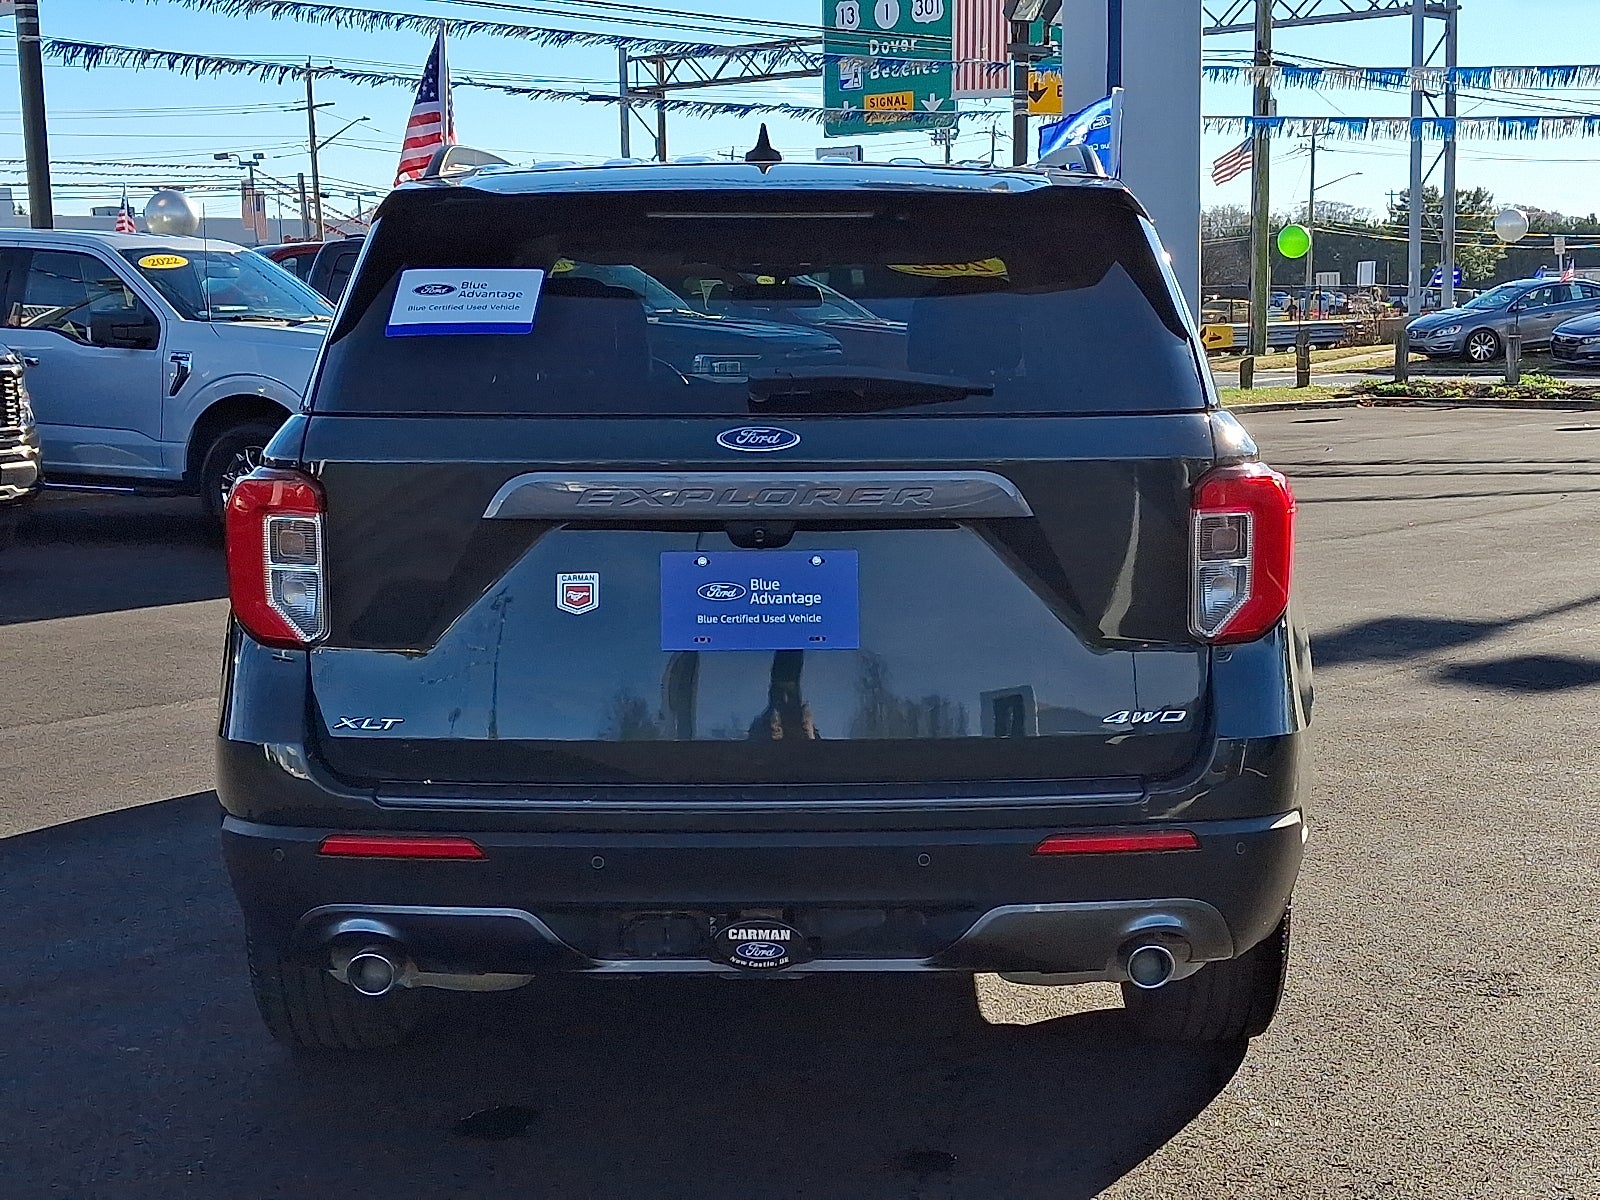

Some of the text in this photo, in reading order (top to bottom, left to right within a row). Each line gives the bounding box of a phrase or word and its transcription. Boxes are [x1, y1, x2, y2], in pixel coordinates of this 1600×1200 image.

[885, 3, 890, 21] 1
[914, 0, 940, 17] 301
[840, 6, 855, 25] 13
[869, 39, 918, 56] Dover
[869, 95, 908, 108] SIGNAL
[148, 257, 180, 267] 2022
[420, 284, 449, 295] Ford
[461, 281, 488, 290] Blue
[458, 290, 523, 300] Advantage
[407, 304, 426, 312] Blue
[735, 429, 782, 446] Ford
[575, 486, 936, 508] EXPLORER
[561, 574, 595, 582] CARMAN
[750, 578, 780, 591] Blue
[706, 584, 737, 598] Ford
[750, 592, 822, 606] Advantage
[697, 613, 822, 624] Blue Certified Used Vehicle
[333, 717, 404, 730] XLT
[1102, 710, 1187, 724] 4WD
[728, 929, 791, 940] CARMAN
[745, 942, 776, 957] Ford
